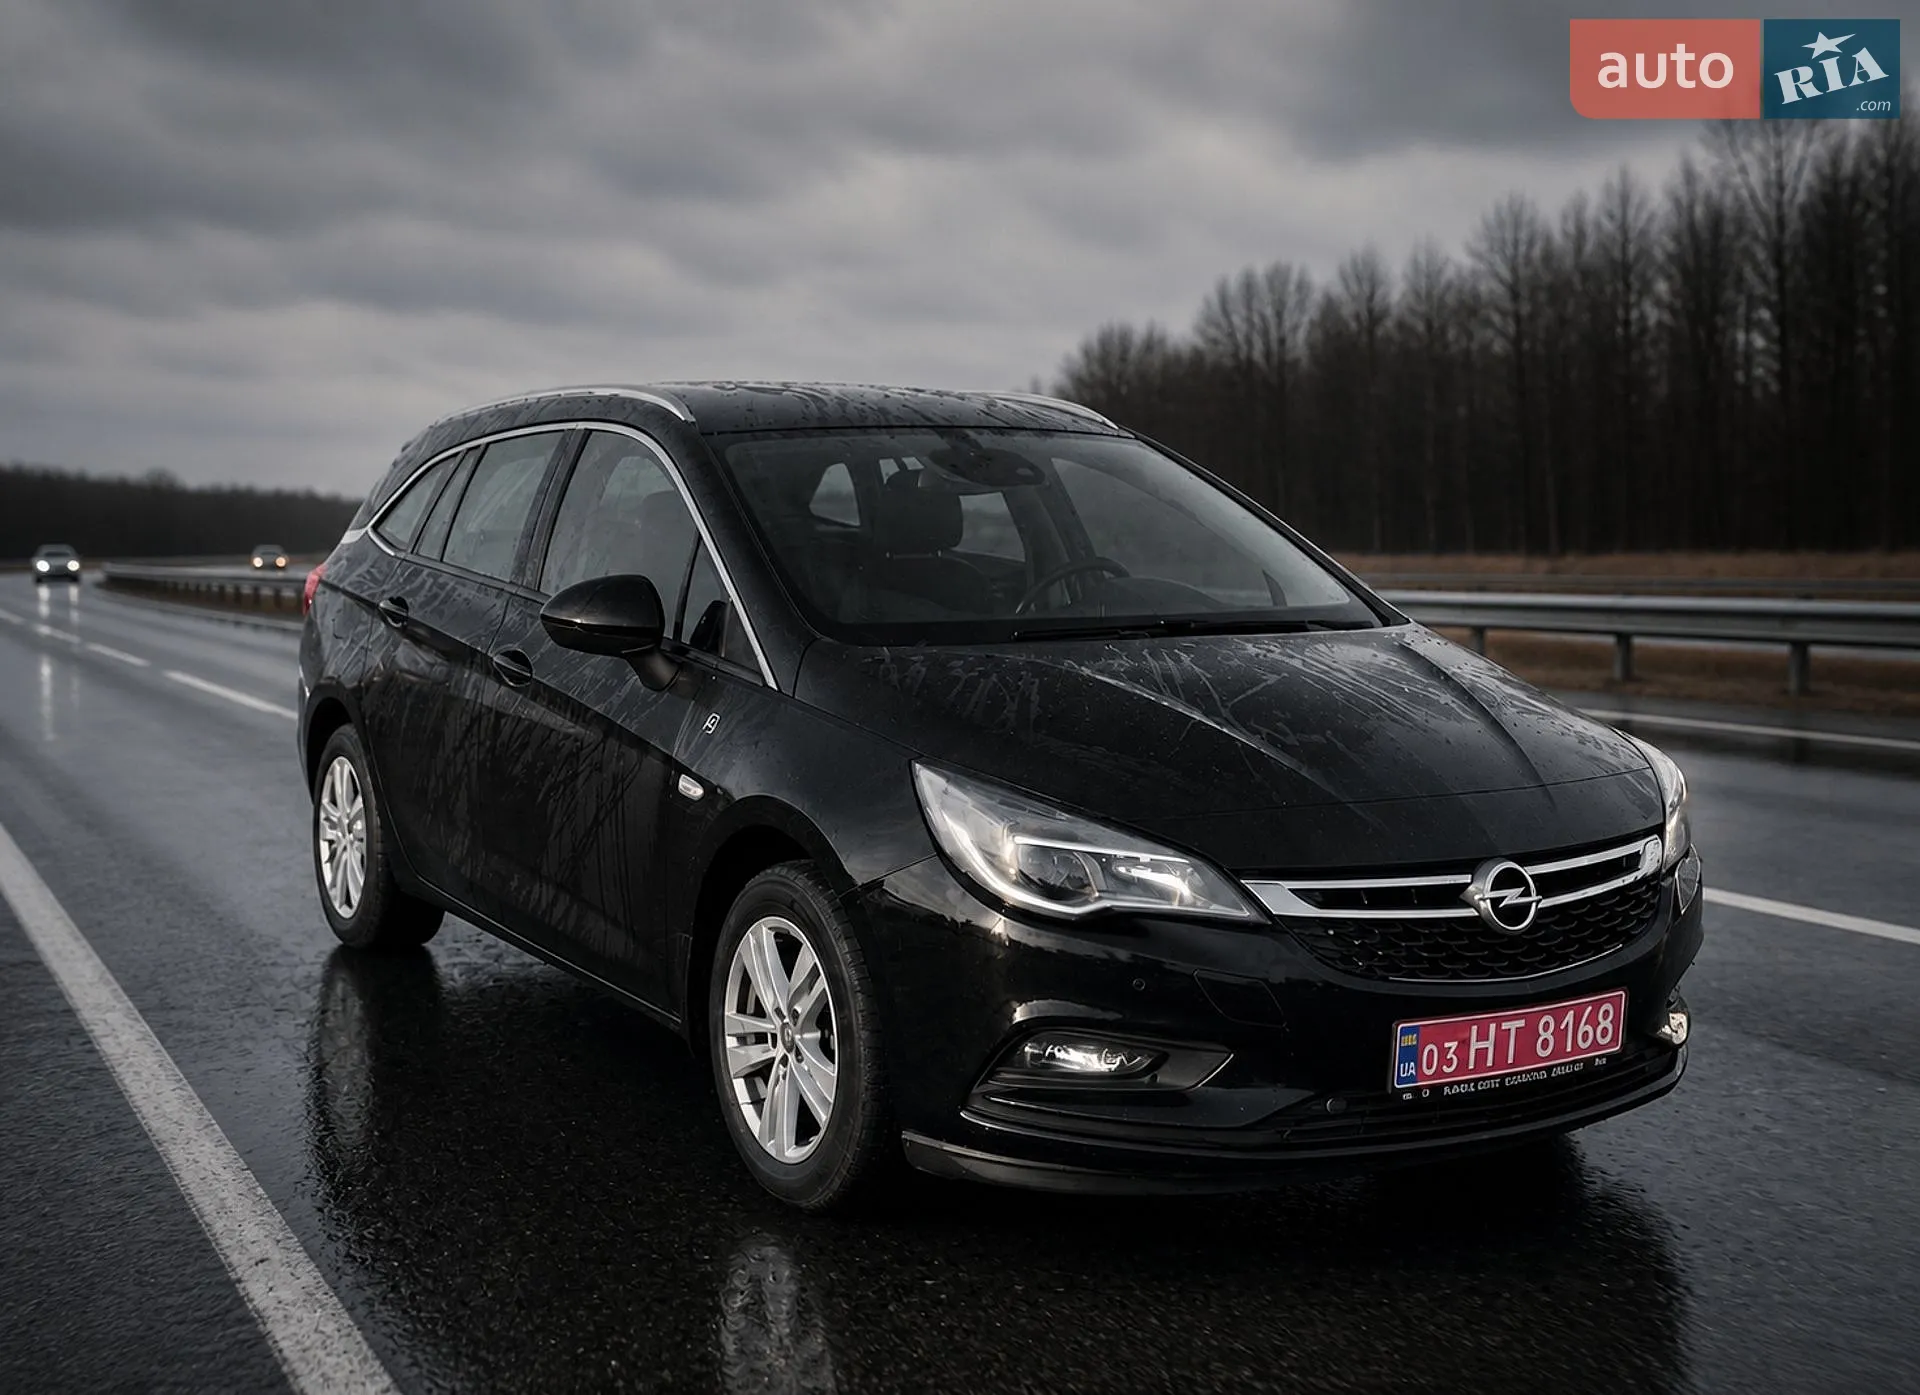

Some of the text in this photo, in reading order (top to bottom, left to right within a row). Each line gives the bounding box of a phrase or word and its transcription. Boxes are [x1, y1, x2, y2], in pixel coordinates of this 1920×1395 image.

[1422, 1002, 1615, 1076] 03 HT 8168
[1400, 1062, 1416, 1078] UA
